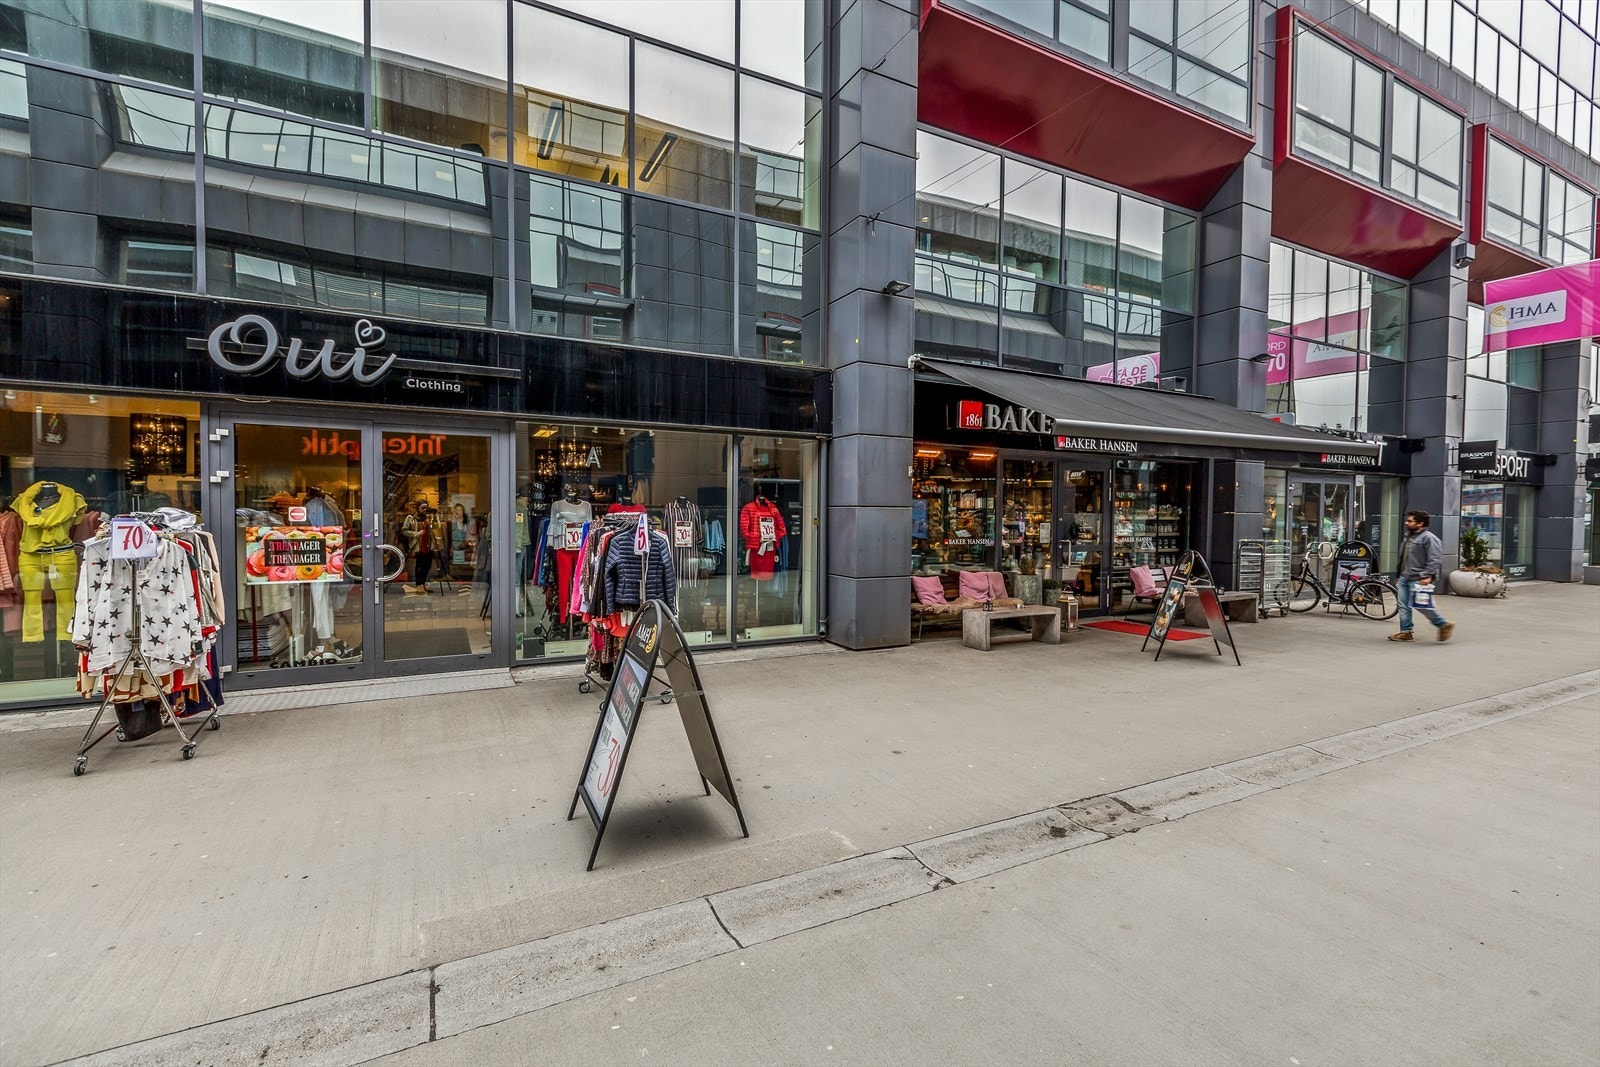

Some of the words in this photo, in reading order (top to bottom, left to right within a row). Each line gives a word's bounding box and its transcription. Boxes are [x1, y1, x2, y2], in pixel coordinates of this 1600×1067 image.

[208, 315, 396, 384] Oui
[1131, 365, 1147, 376] DE
[406, 378, 461, 391] Clothing
[1118, 375, 1146, 385] ESTE
[966, 414, 982, 426] 1861
[1065, 437, 1097, 450] BAKER
[1100, 440, 1138, 452] HANSEN
[1327, 455, 1346, 463] BAKER
[1347, 456, 1371, 465] HANSEN
[117, 525, 154, 551] 70%
